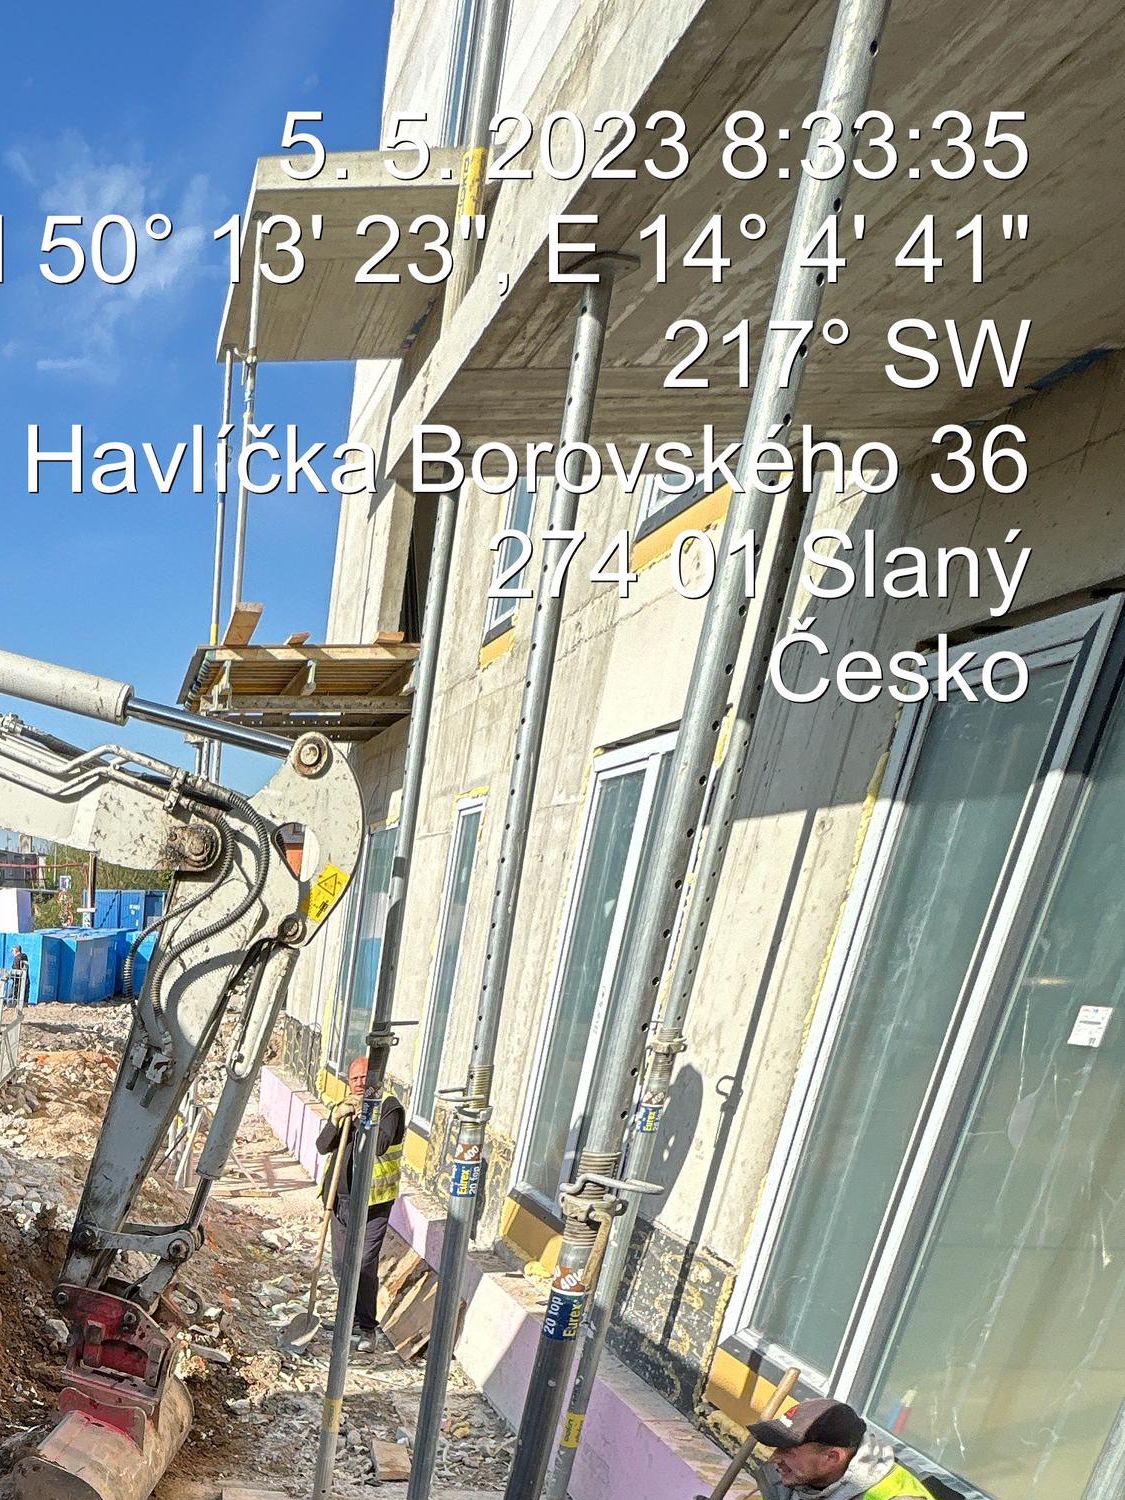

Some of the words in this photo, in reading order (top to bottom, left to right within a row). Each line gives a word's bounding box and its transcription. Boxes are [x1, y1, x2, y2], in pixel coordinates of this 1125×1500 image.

[548, 1296, 564, 1316] top
[544, 1317, 556, 1335] 20
[562, 1301, 583, 1337] Eurex
